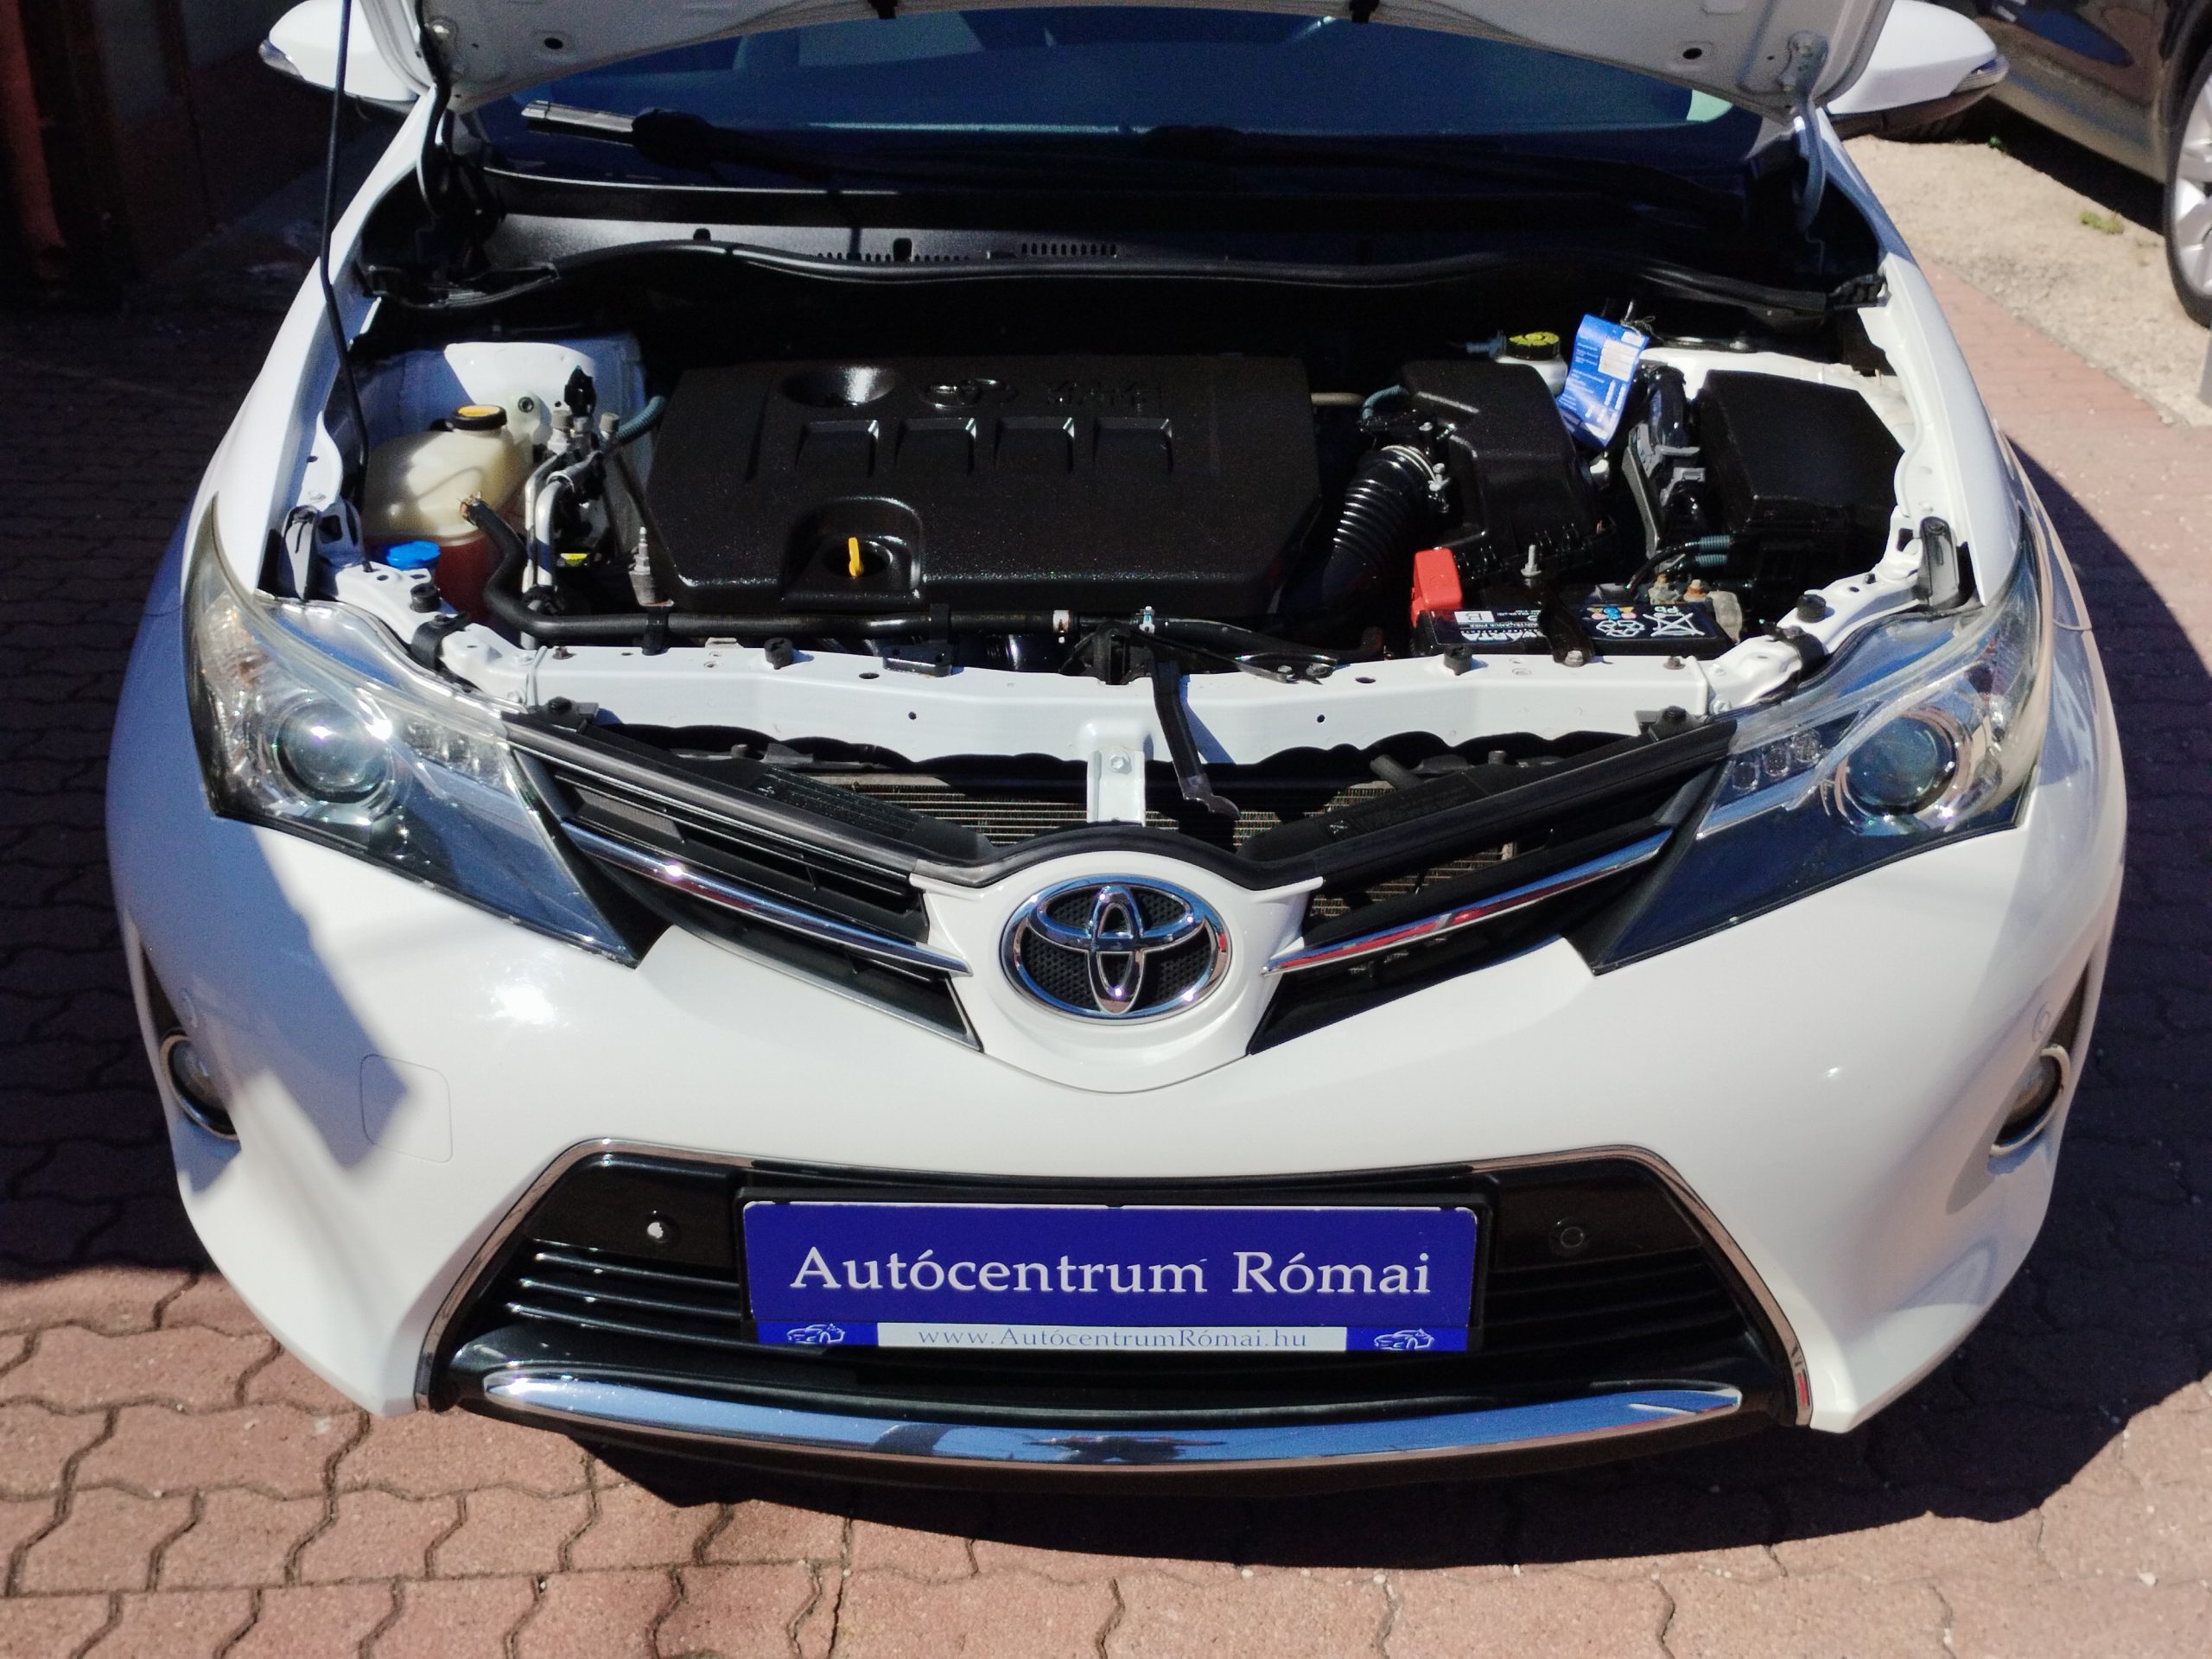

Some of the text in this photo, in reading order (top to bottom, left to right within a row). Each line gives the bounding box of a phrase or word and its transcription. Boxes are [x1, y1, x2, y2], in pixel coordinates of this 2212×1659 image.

[790, 1245, 1431, 1294] Autócentrum Római
[918, 1327, 1307, 1348] www.AutócentrumRómai.hu
